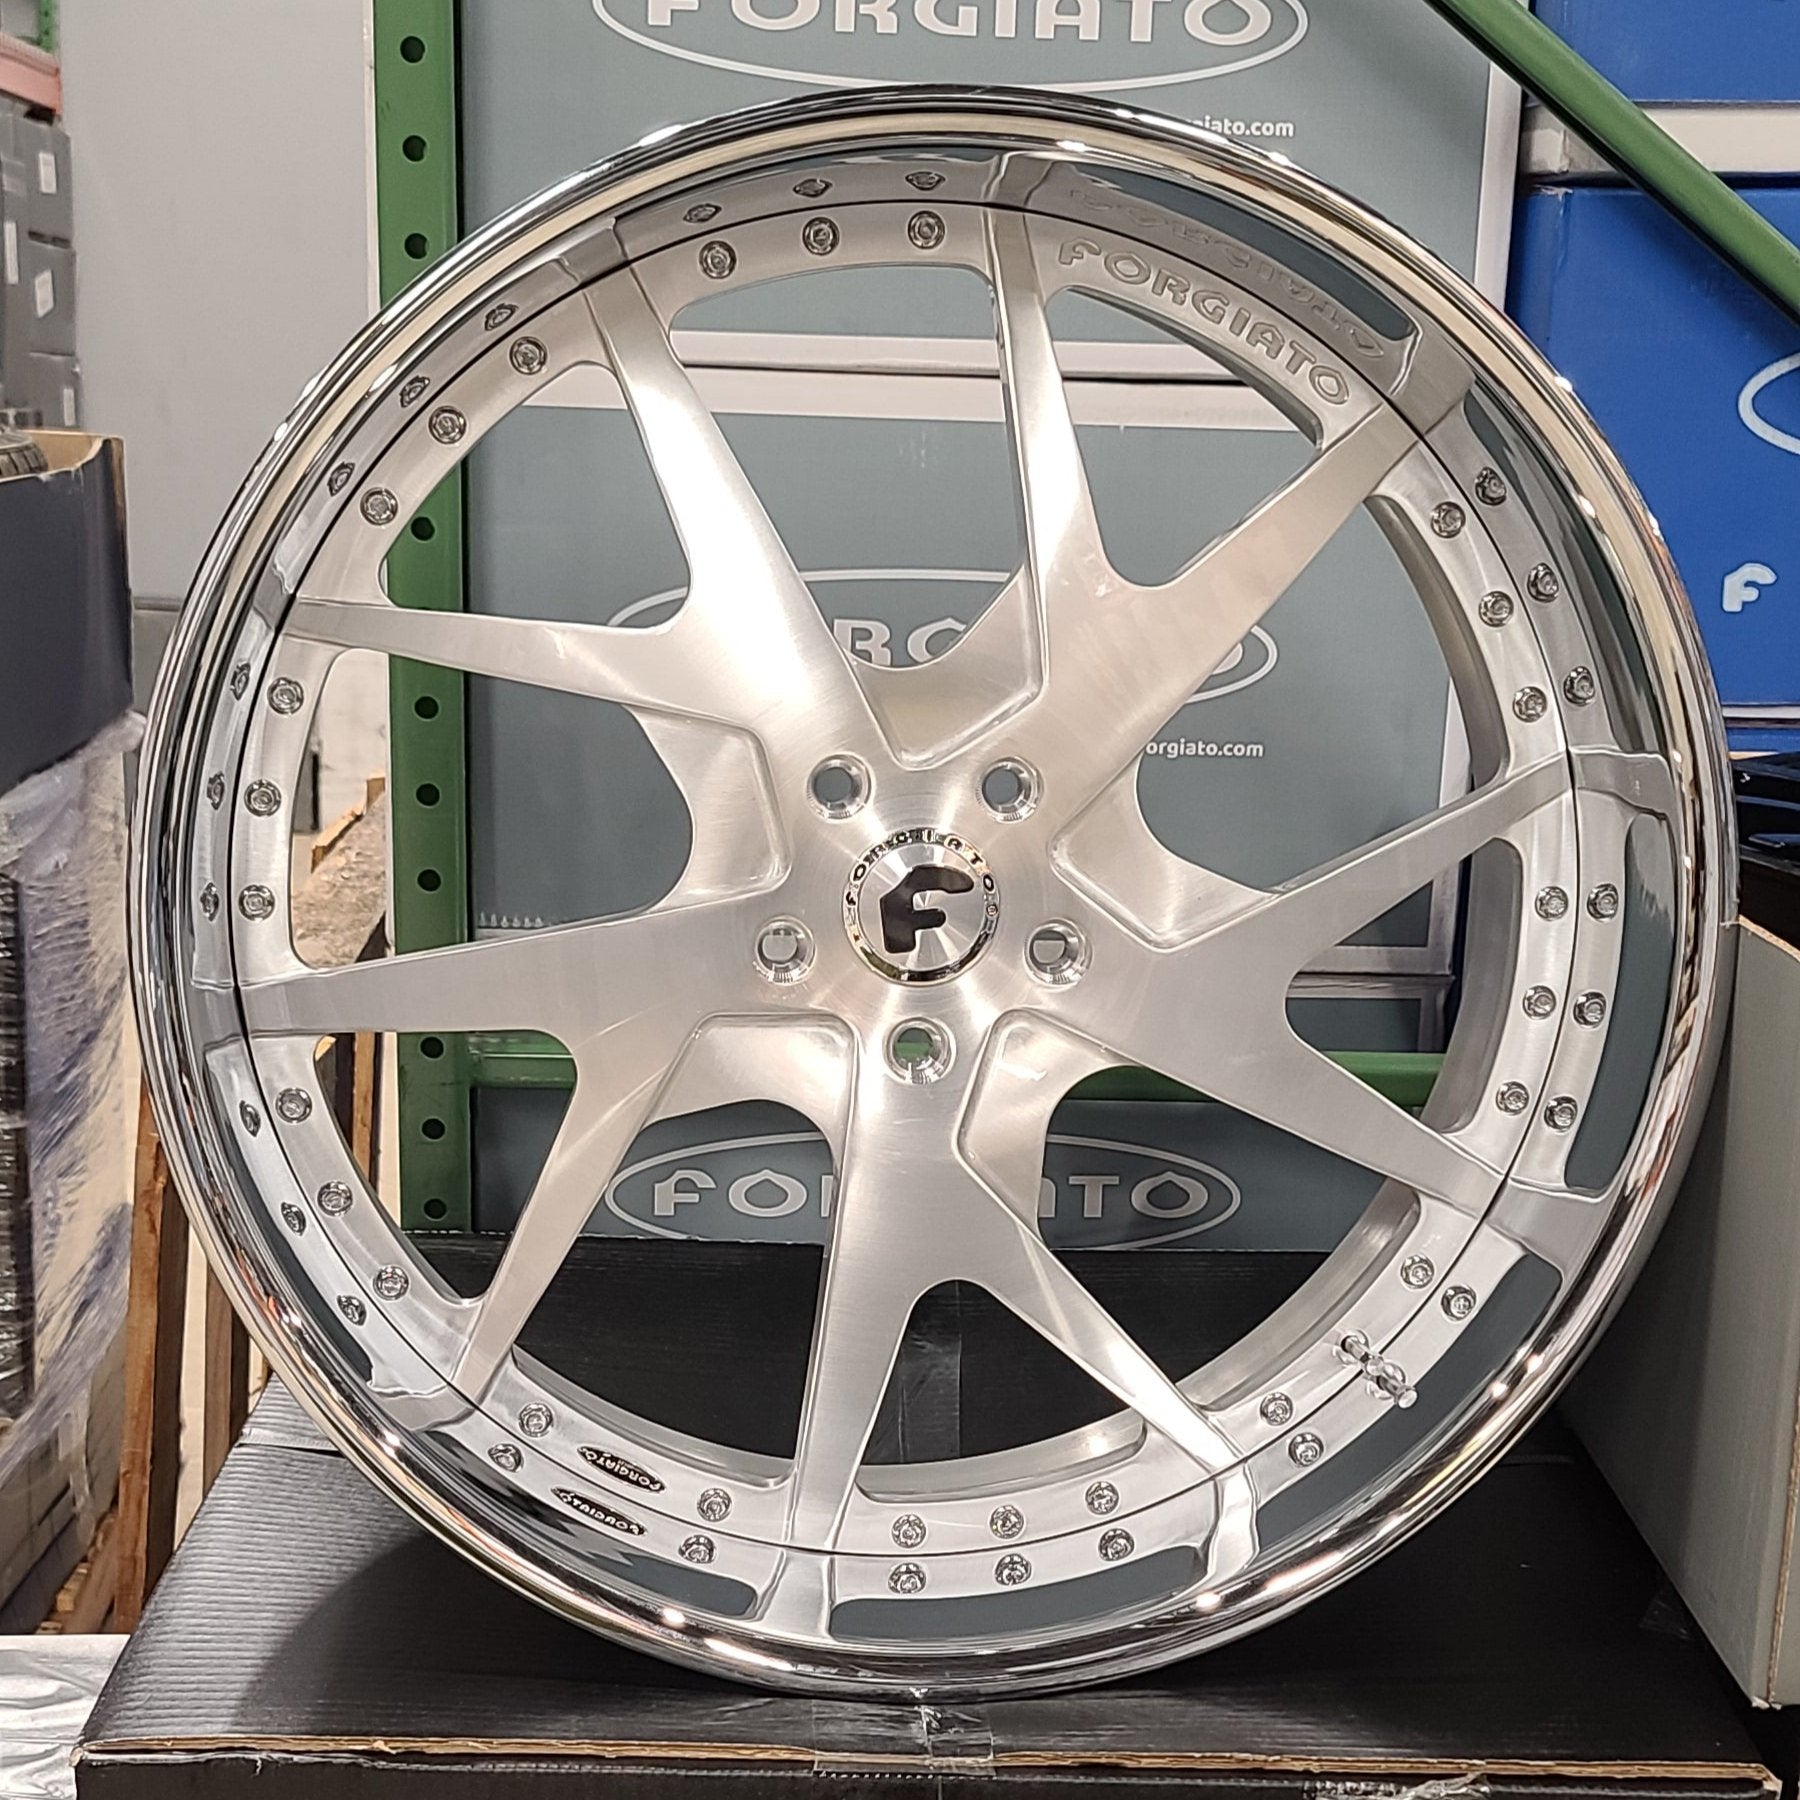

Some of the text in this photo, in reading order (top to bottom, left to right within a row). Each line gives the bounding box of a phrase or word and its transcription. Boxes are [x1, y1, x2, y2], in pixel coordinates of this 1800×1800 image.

[1057, 237, 1351, 405] FORGIATO
[1722, 562, 1777, 612] F
[880, 863, 975, 954] F
[582, 1447, 663, 1491] FORGIATO
